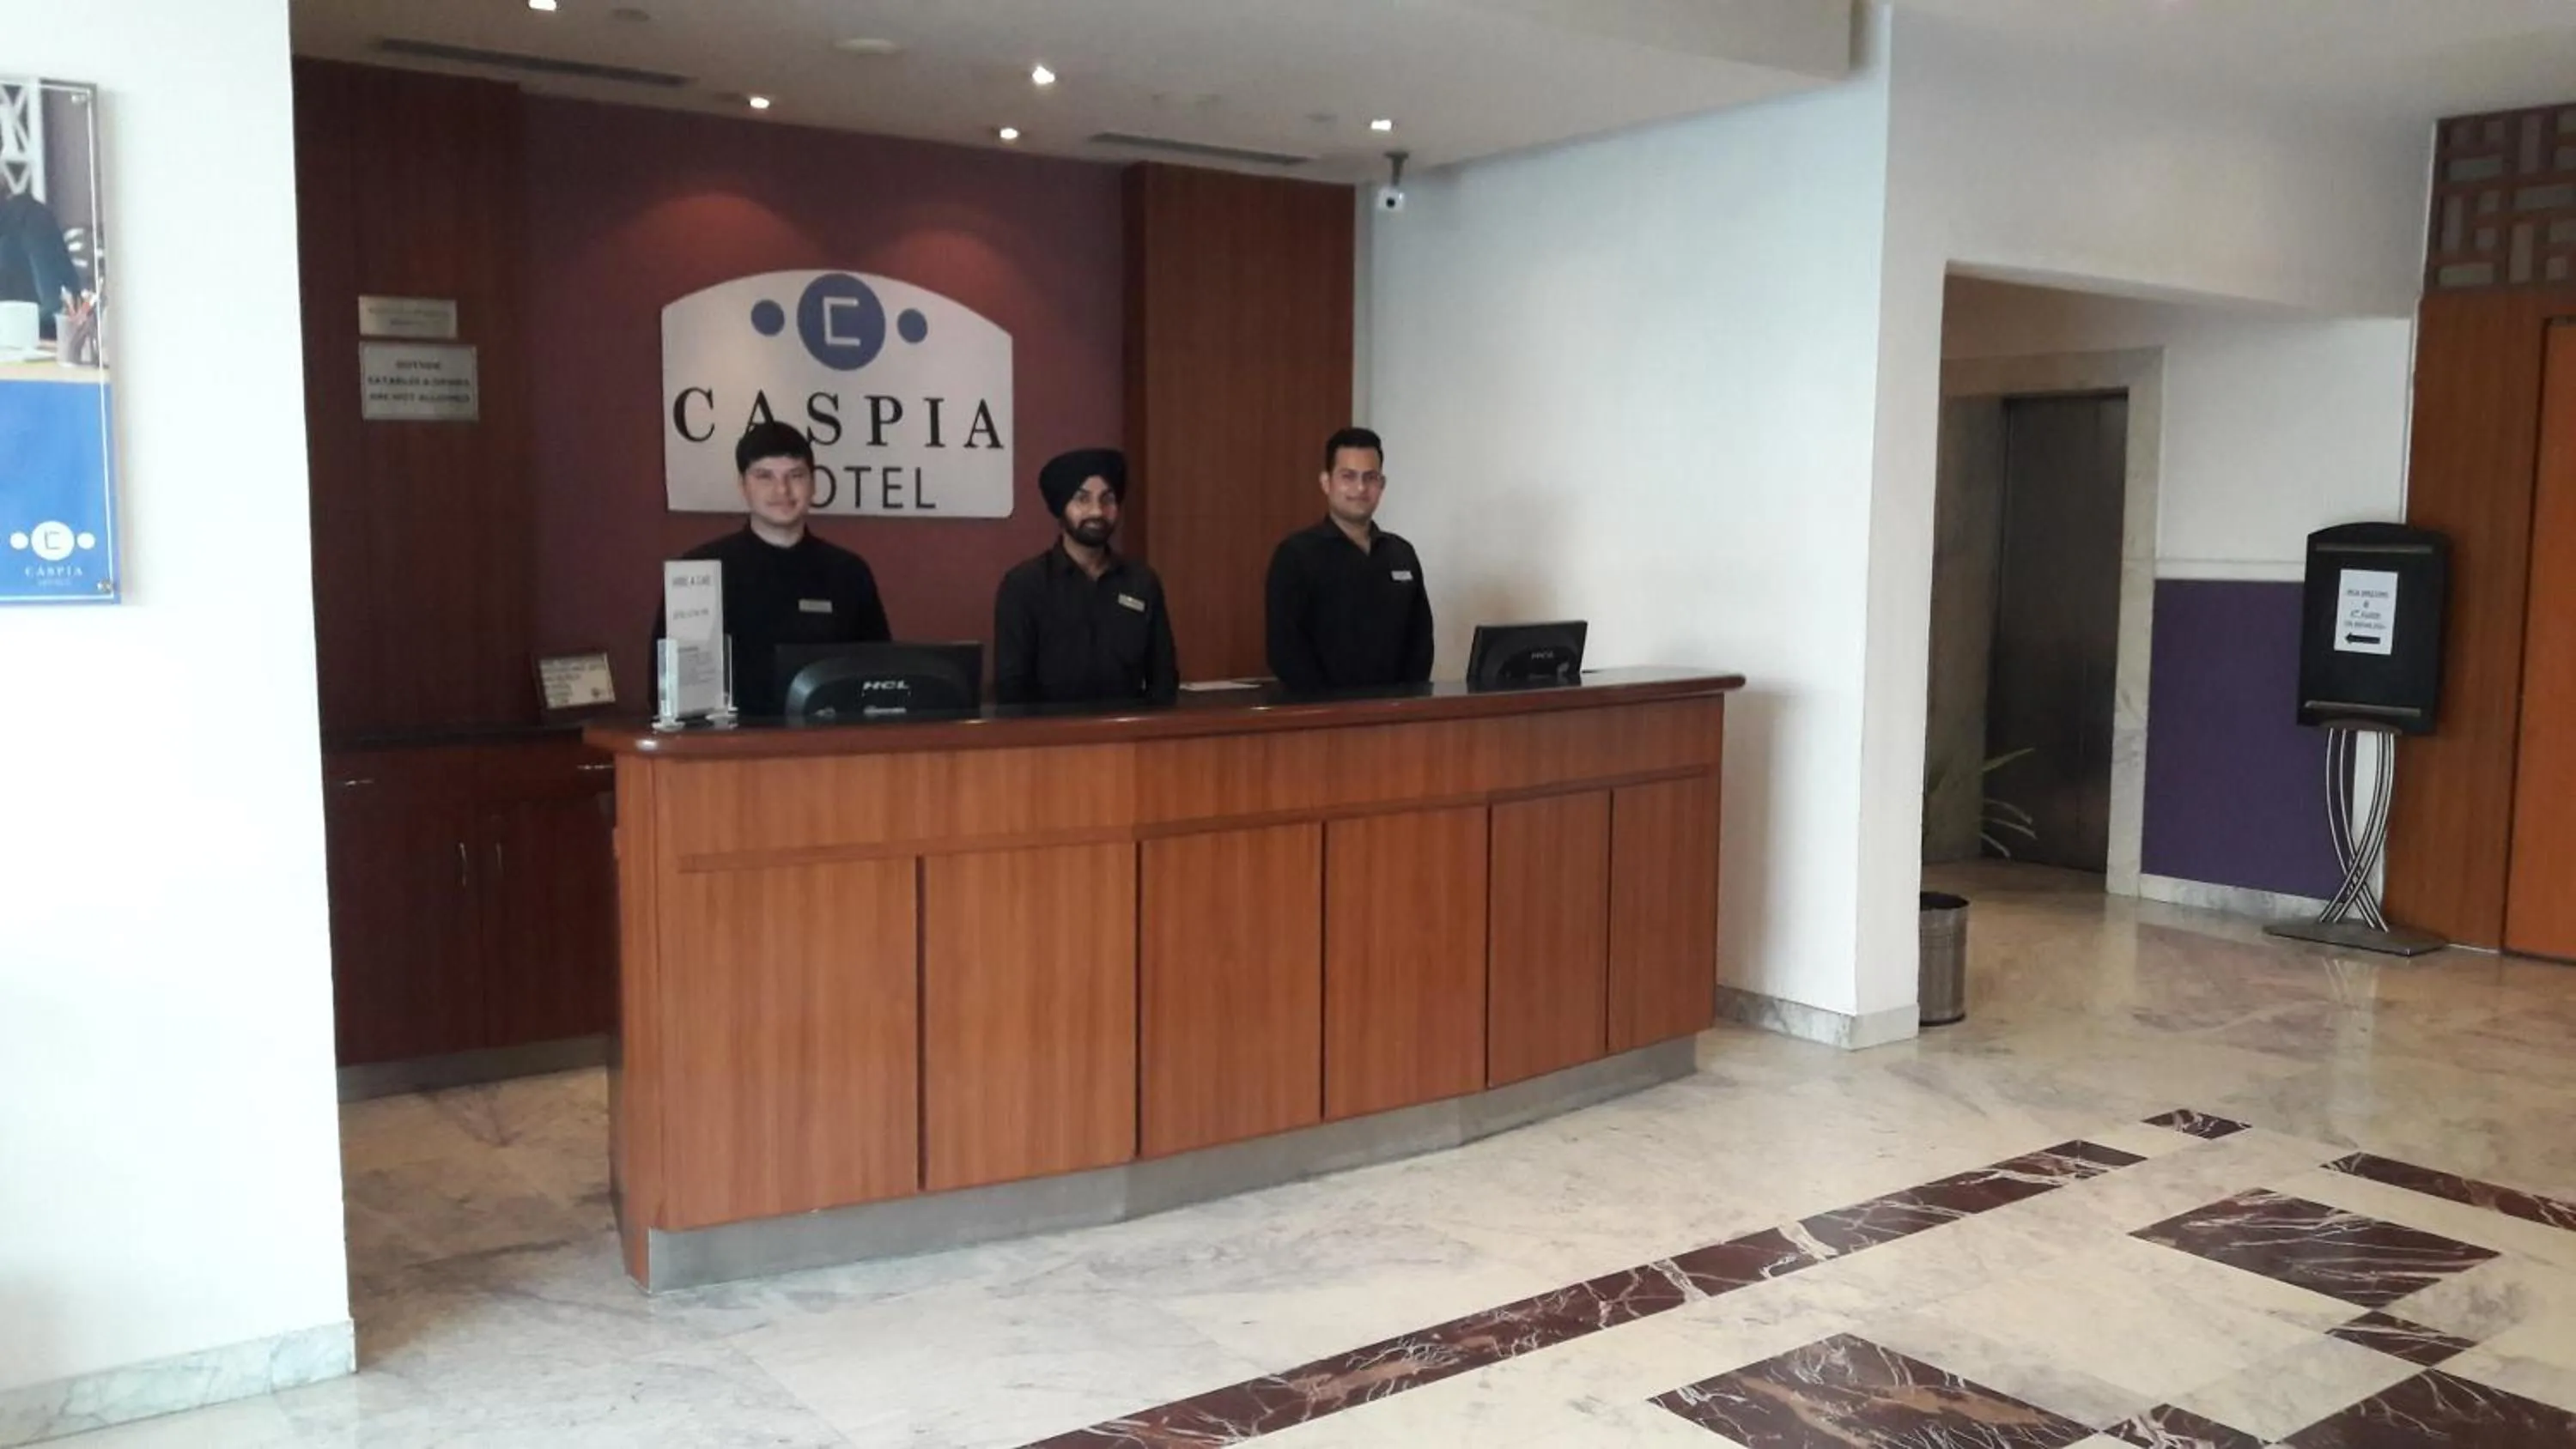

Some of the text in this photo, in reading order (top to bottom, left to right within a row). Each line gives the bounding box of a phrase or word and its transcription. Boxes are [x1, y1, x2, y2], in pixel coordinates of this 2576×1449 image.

[673, 387, 1004, 449] CASPIA
[807, 465, 936, 510] OTEL
[863, 680, 908, 689] HCL
